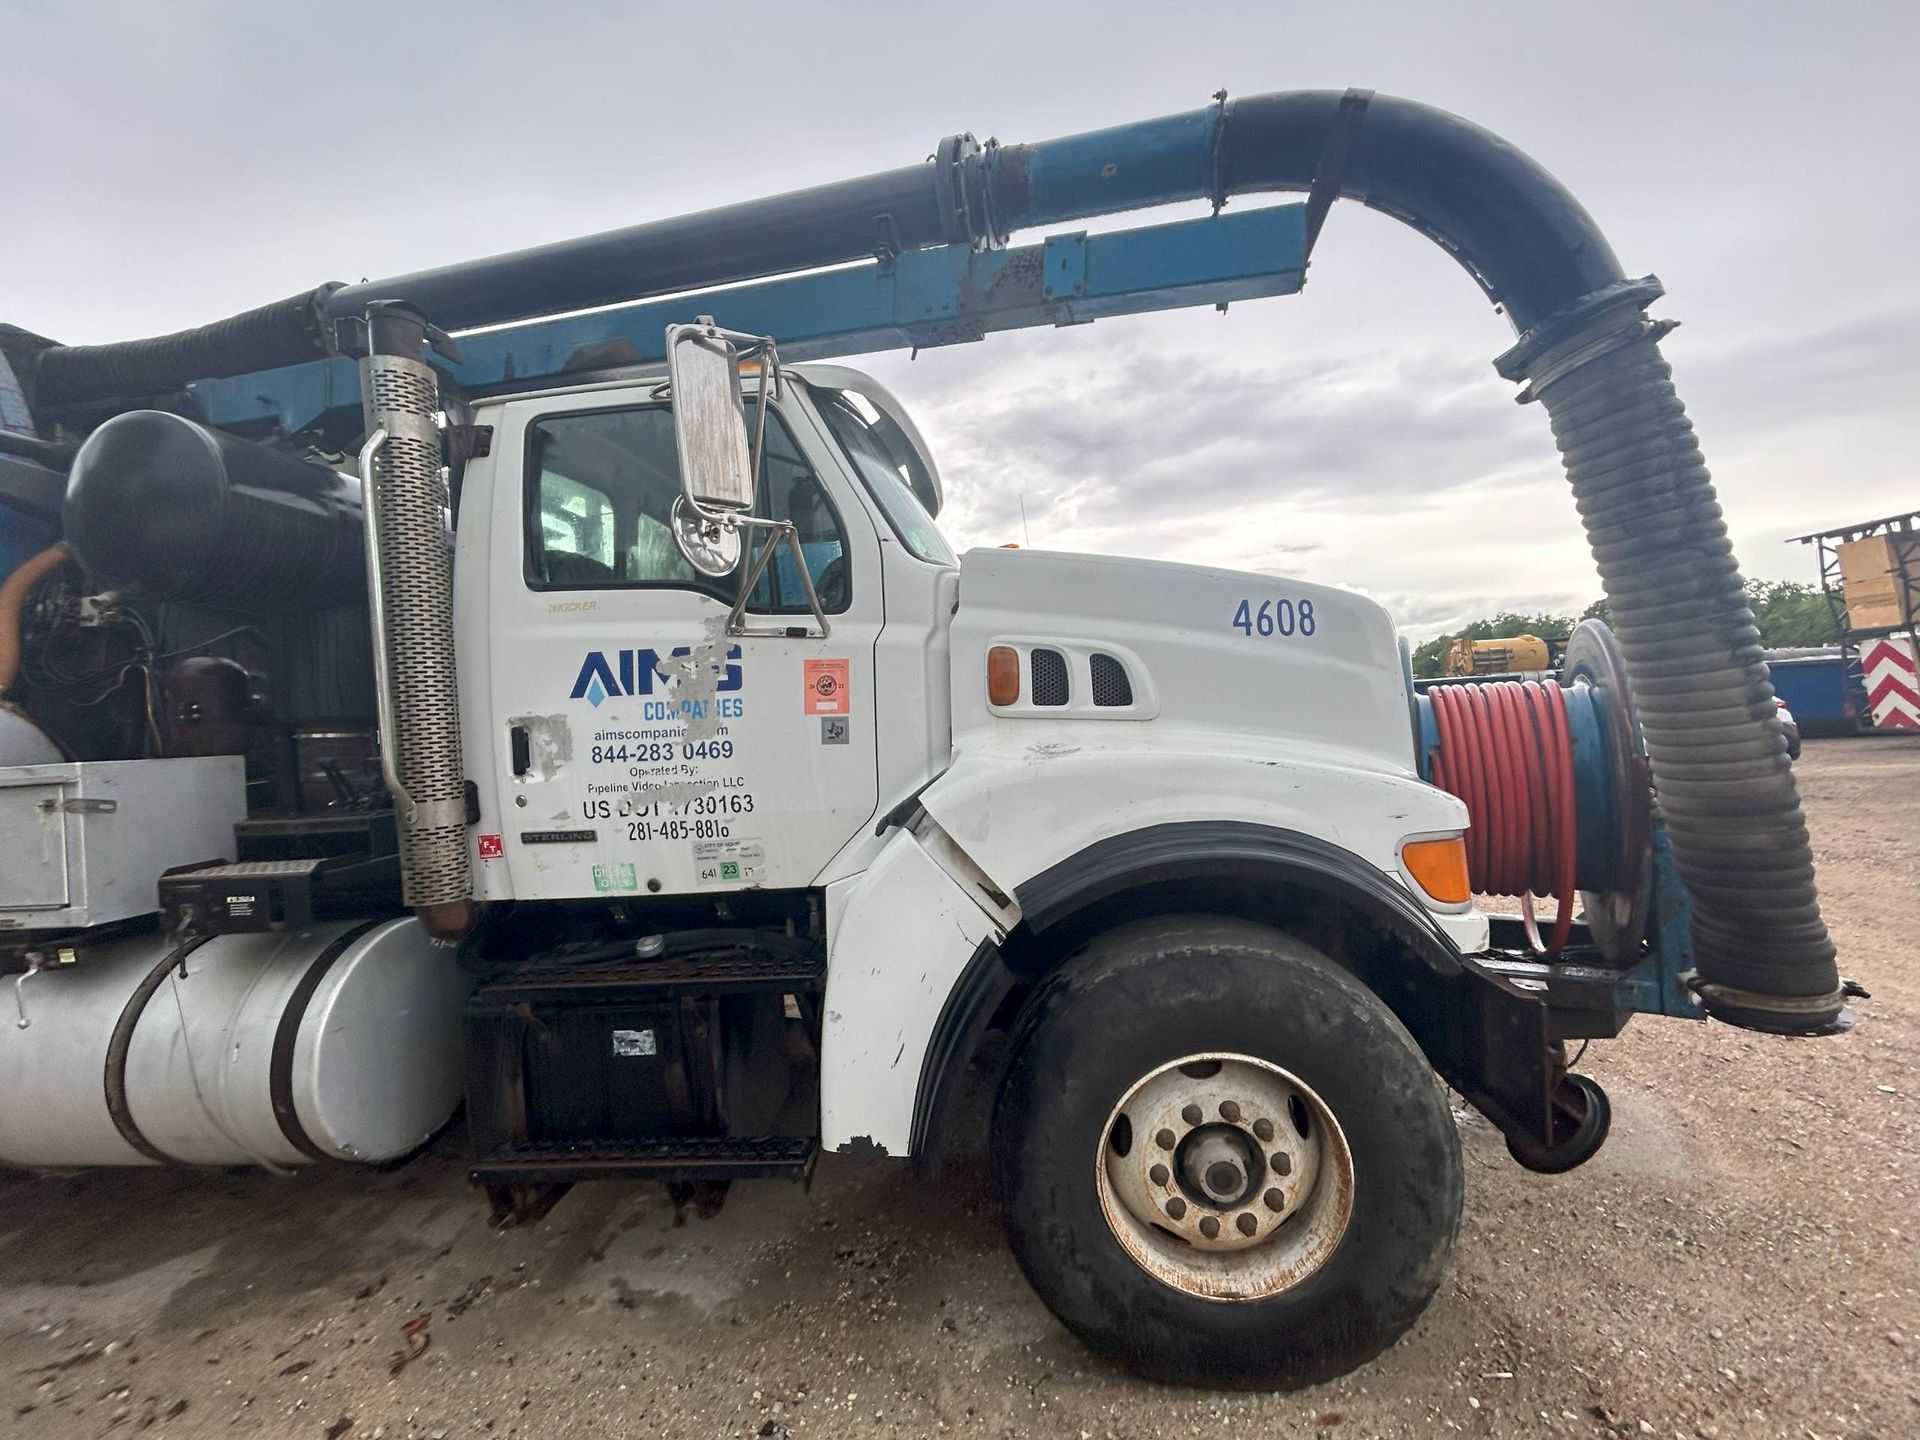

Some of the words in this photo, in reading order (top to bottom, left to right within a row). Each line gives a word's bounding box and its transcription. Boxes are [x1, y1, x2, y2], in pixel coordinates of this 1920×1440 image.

[1232, 599, 1316, 636] 4608
[591, 740, 734, 764] 844-2830469
[588, 781, 629, 794] Pipeline
[632, 779, 661, 793] Video
[722, 777, 745, 787] LLC
[583, 800, 611, 819] US
[723, 864, 737, 875] 23
